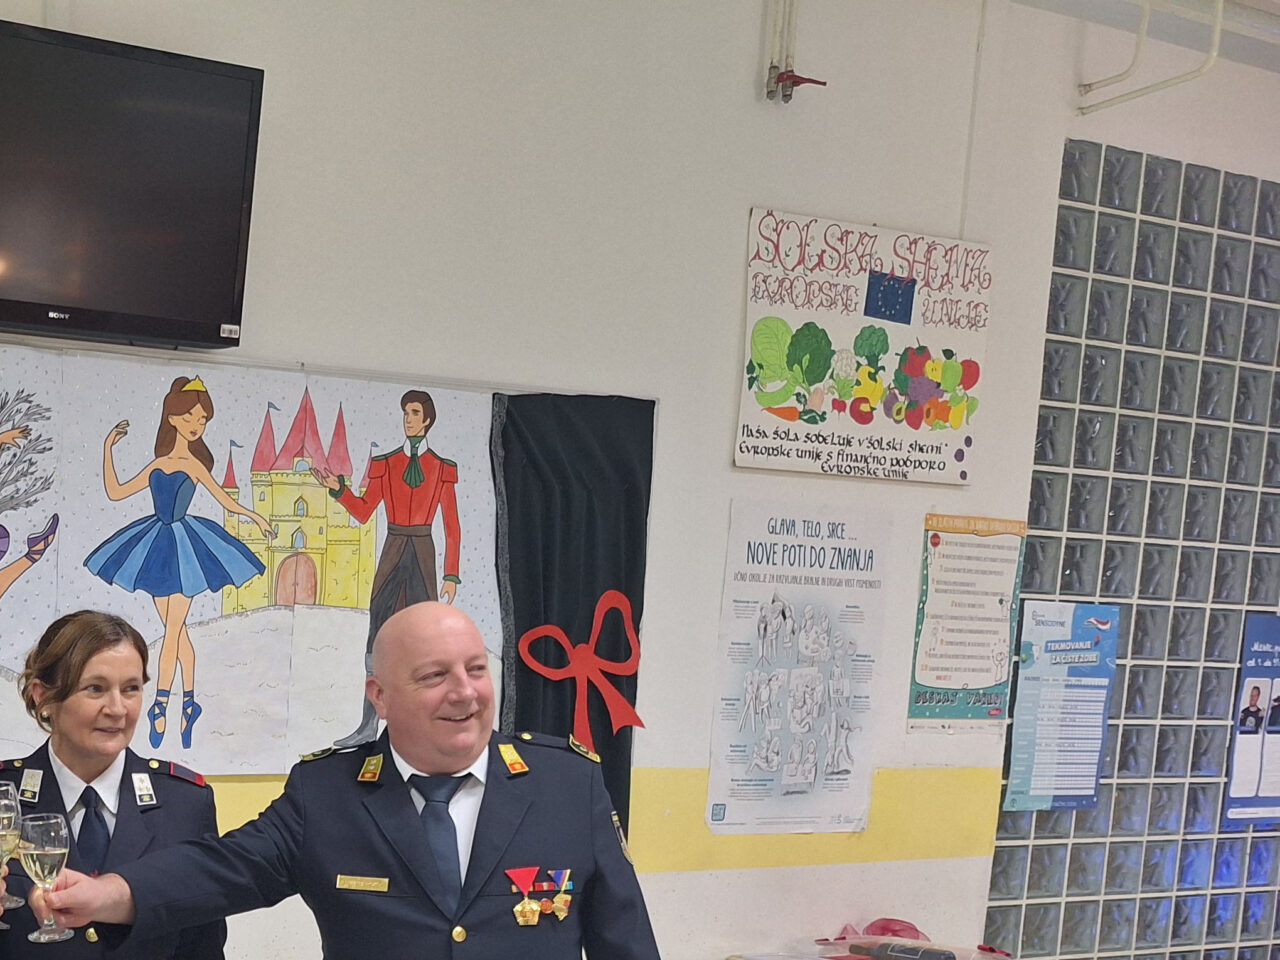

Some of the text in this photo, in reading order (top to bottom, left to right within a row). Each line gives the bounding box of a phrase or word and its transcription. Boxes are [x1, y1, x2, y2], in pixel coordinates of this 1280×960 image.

[748, 210, 992, 294] ŠOLSKA SHEMA
[750, 271, 860, 316] EVROPSKE
[48, 311, 71, 319] SONY
[921, 298, 990, 331] UNIJE
[767, 517, 799, 538] GLAVA,
[802, 520, 824, 540] TELO,
[827, 522, 846, 540] SRCE
[746, 540, 874, 572] NOVE POTI DO ZNANJA
[1047, 641, 1092, 651] TEKMOVANJE
